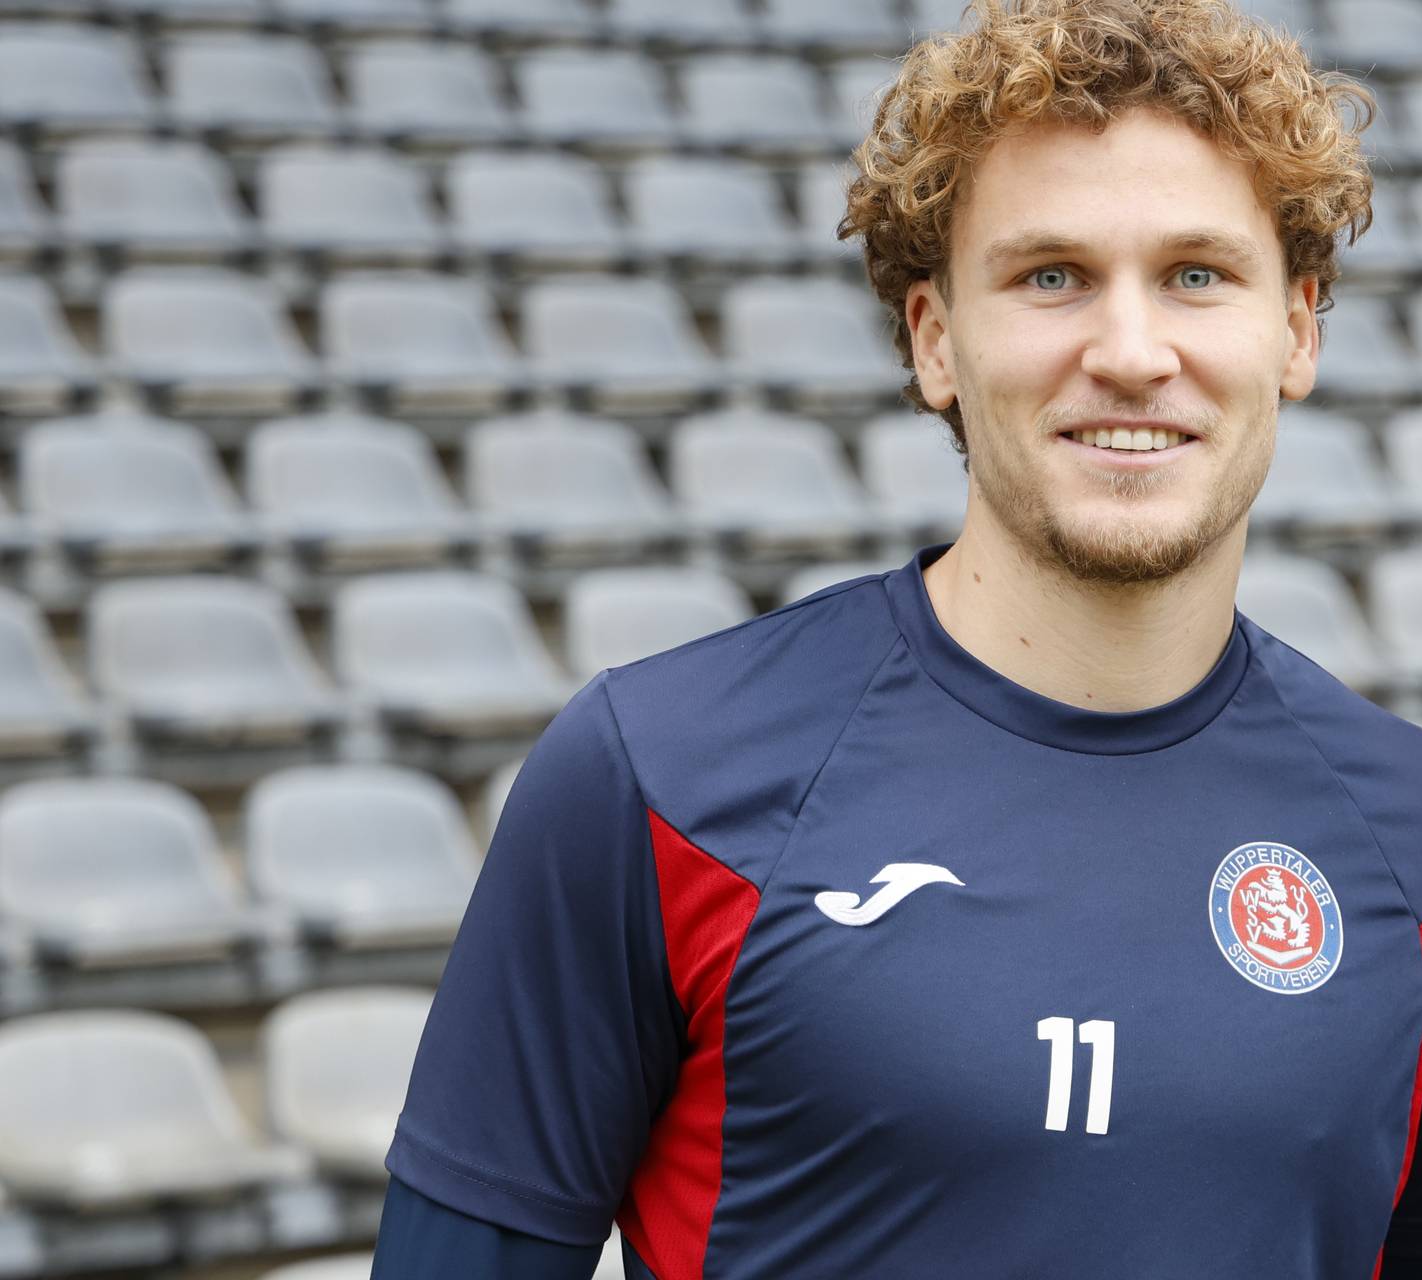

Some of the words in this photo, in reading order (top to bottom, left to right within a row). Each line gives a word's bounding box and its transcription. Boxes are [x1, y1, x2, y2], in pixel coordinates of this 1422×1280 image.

[1216, 848, 1331, 907] WUPPERTALER
[1228, 943, 1331, 987] SPORTVEREIN
[1037, 1016, 1115, 1135] 11
